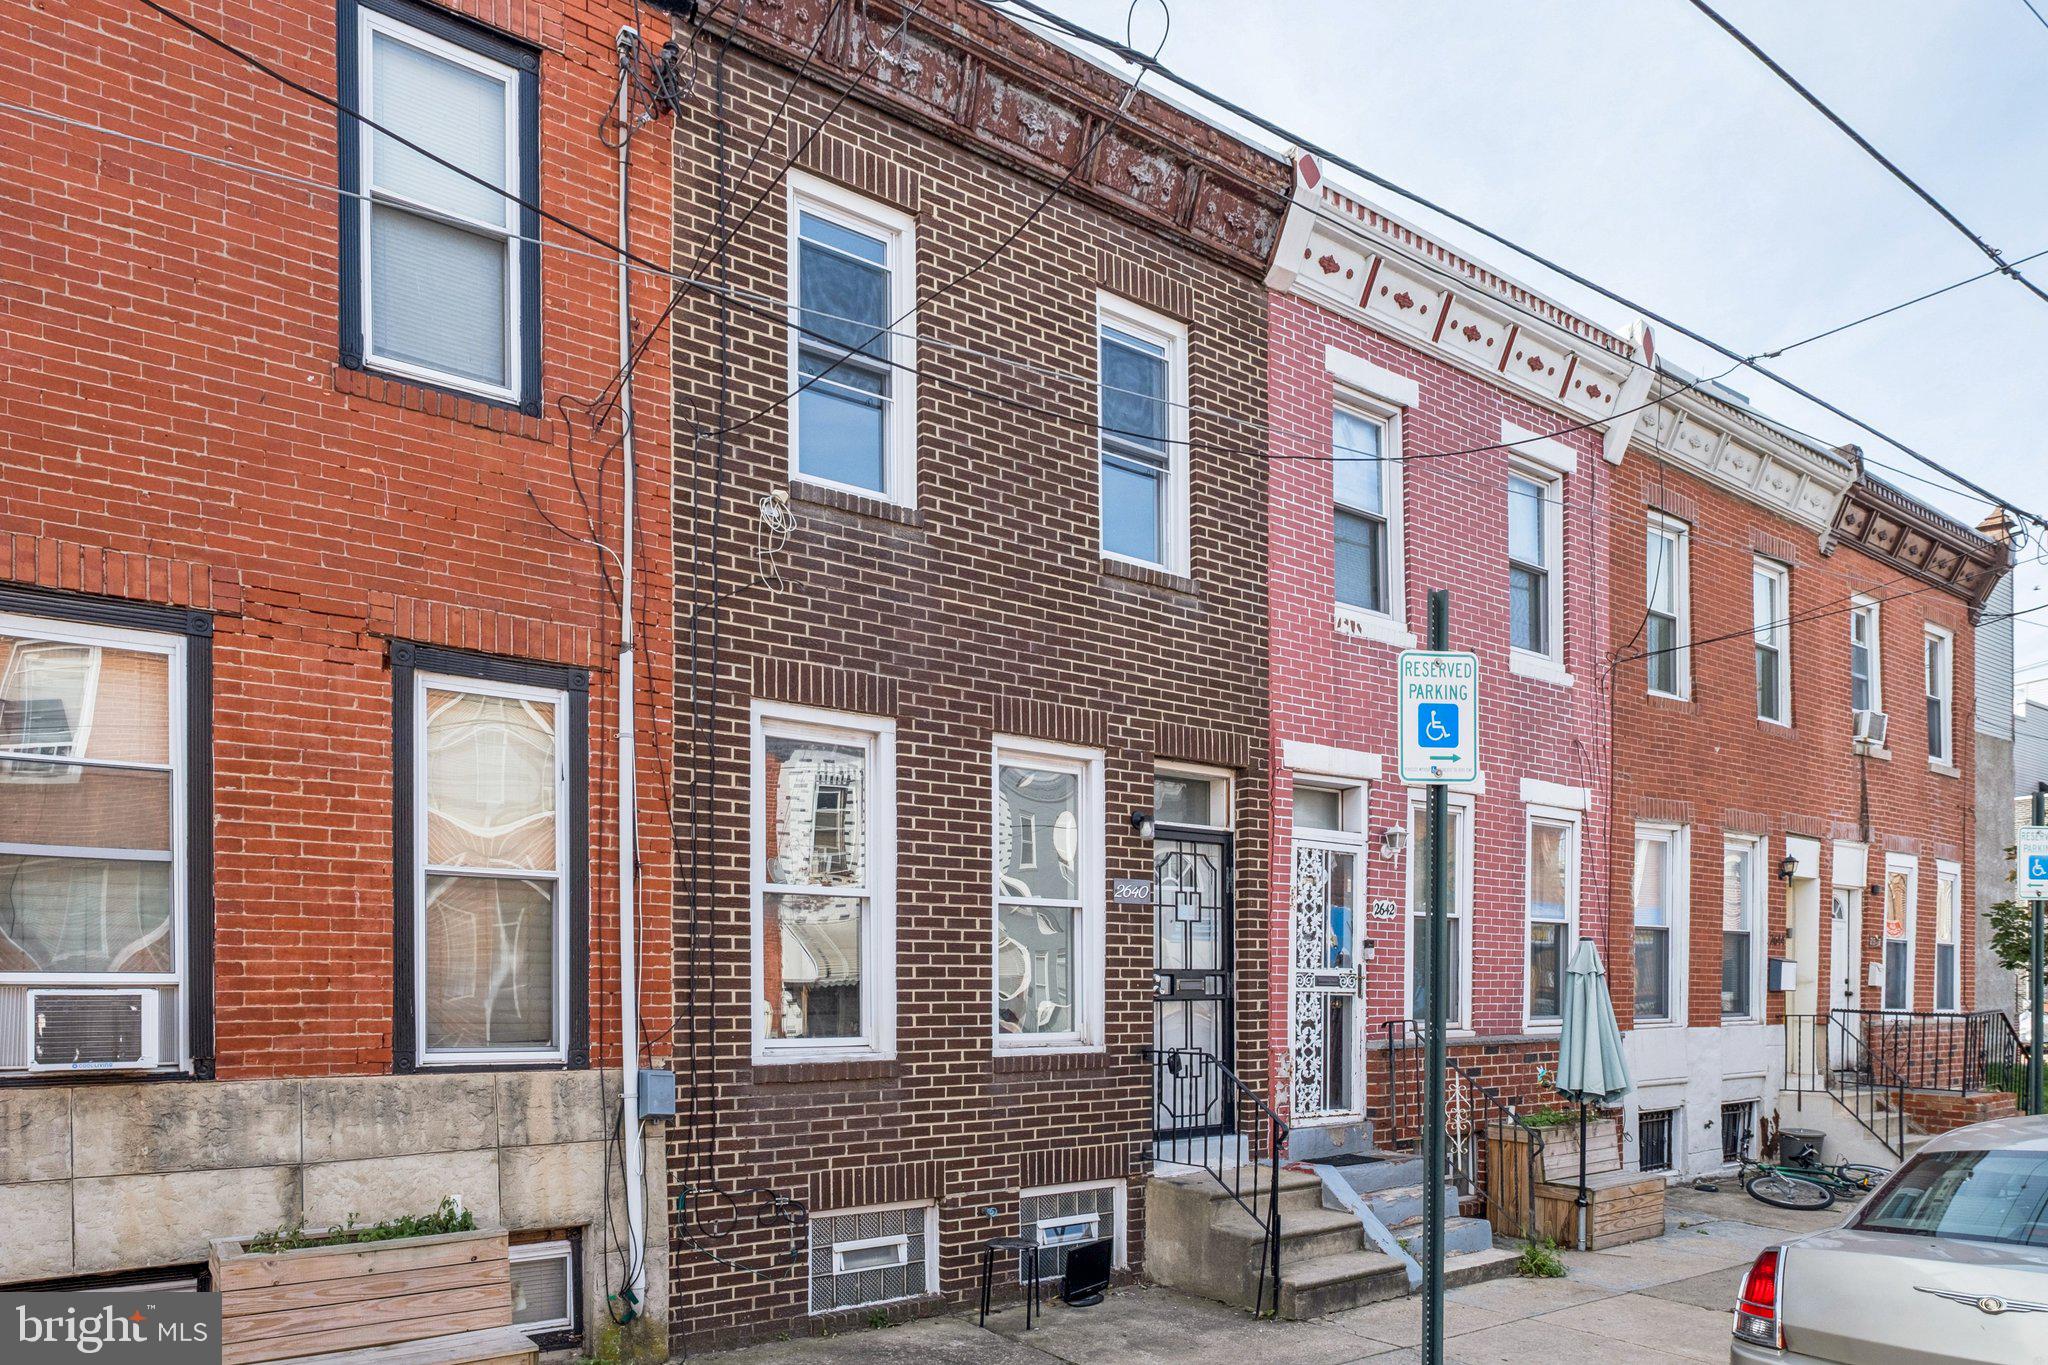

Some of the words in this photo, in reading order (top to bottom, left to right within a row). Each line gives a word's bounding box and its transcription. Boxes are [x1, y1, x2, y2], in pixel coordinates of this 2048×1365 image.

[1405, 661, 1472, 679] RESERVED
[1409, 683, 1468, 701] PARKING
[1114, 884, 1149, 899] 2640
[1374, 902, 1395, 916] 2642
